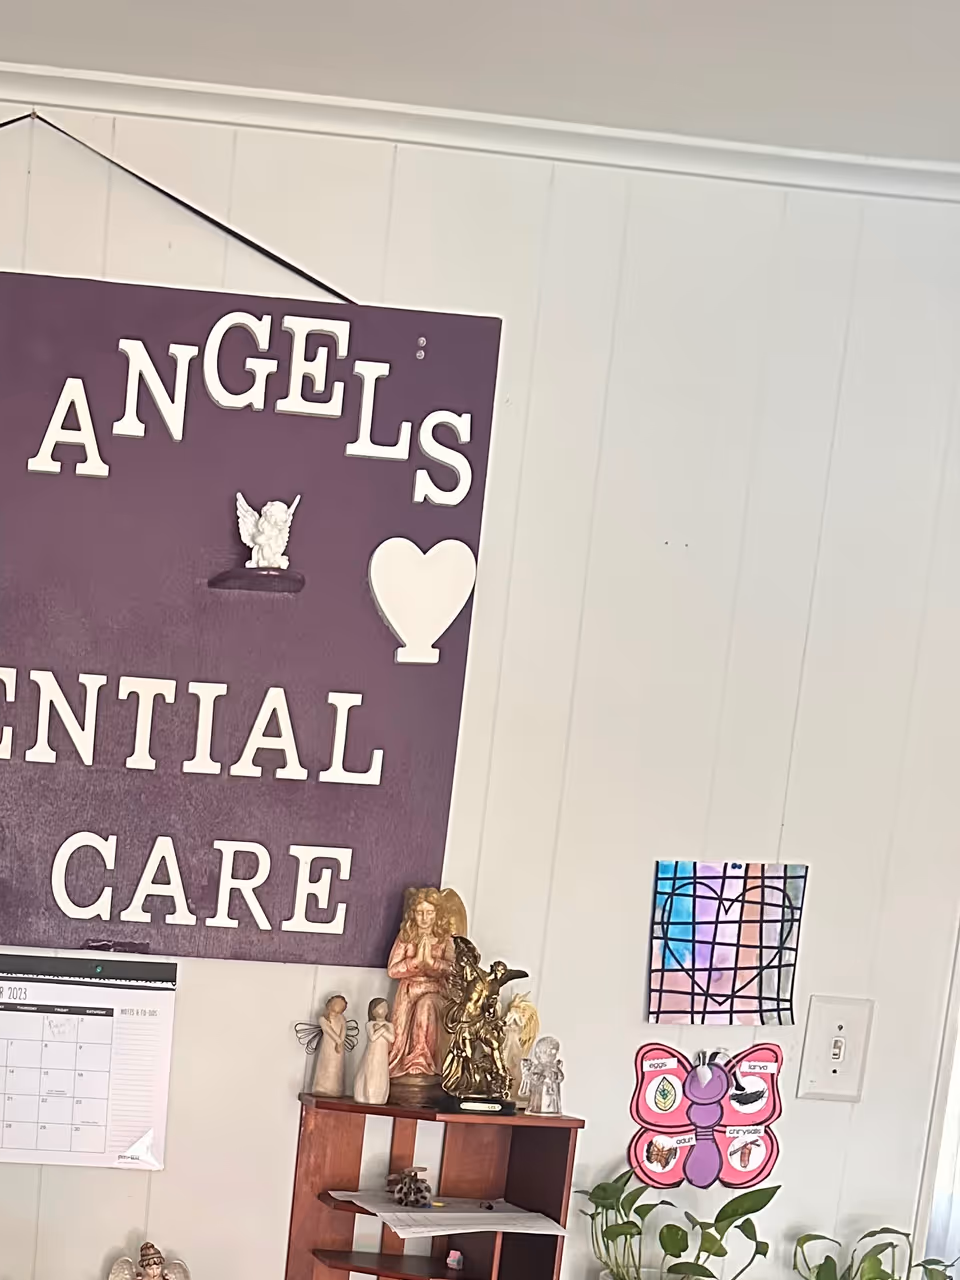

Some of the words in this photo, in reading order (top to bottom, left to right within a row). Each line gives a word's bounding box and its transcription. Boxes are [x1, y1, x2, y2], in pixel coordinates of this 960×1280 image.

[27, 310, 474, 506] ANGELS
[51, 831, 353, 935] CARE
[7, 986, 28, 1001] 2023
[648, 1061, 667, 1069] eggs
[748, 1063, 768, 1071] larva
